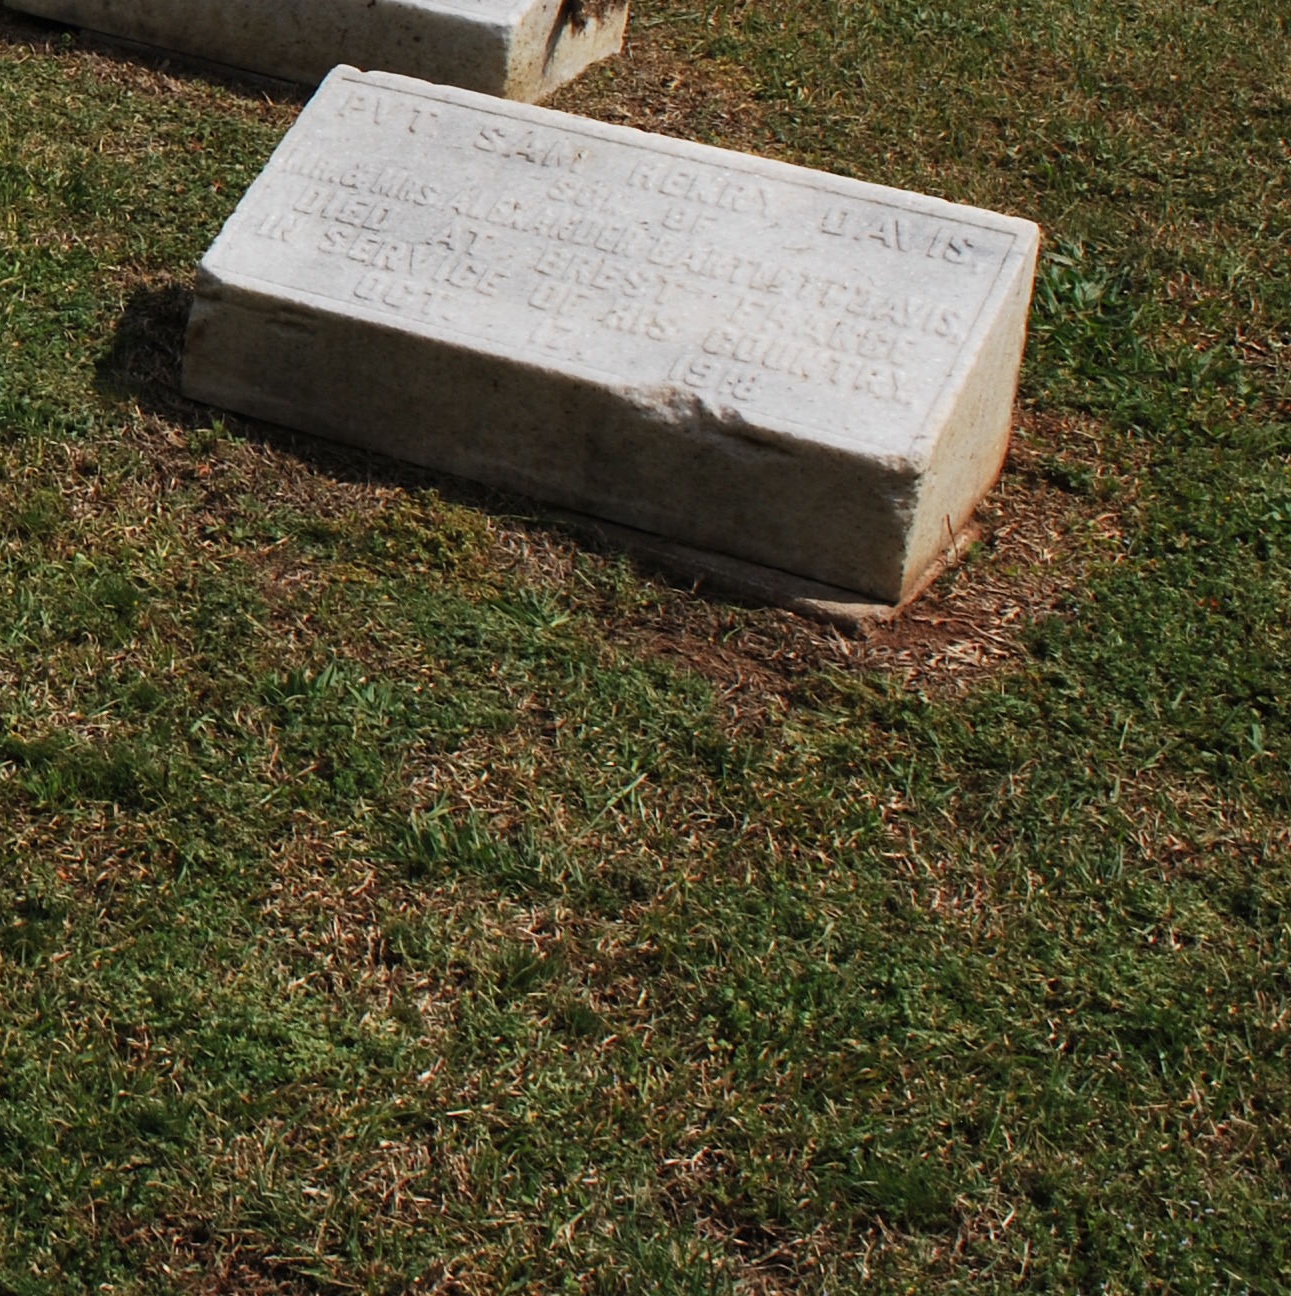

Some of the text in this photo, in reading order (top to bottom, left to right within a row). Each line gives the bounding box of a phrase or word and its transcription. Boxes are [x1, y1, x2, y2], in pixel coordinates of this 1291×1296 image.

[466, 123, 594, 176] SAM
[622, 159, 786, 222] HENRY
[543, 177, 718, 239] SON OF
[253, 209, 303, 243] IN
[313, 225, 511, 299] SERVICE
[525, 280, 591, 319] OF
[597, 299, 682, 343] HIS
[290, 185, 400, 234] DIED
[424, 219, 499, 260] AT
[528, 245, 688, 308] BREST
[666, 353, 769, 403] 1918
